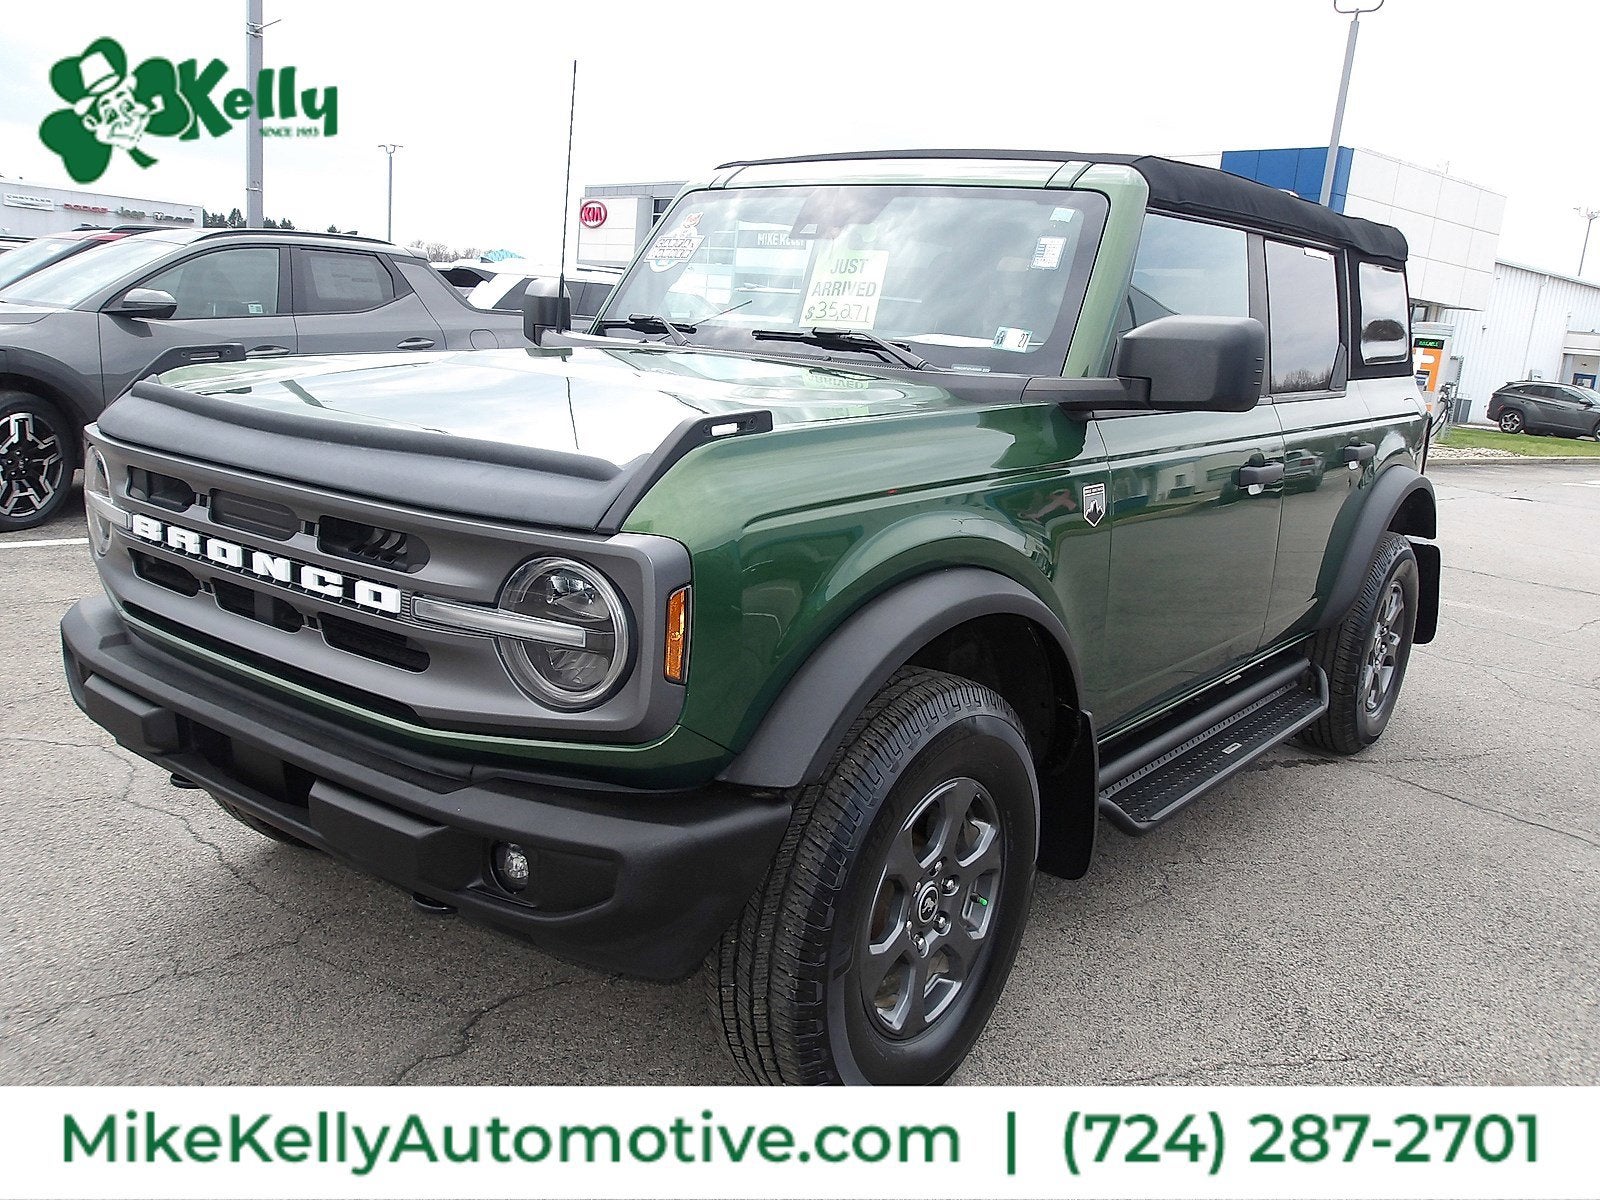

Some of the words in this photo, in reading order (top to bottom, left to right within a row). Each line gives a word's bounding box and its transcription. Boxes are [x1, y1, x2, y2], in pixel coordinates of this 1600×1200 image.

[116, 206, 146, 219] Jeep
[583, 206, 603, 222] KIA
[757, 232, 778, 246] MIKE
[830, 258, 869, 274] JUST
[811, 281, 877, 297] ARRIVED
[130, 512, 403, 615] BRONCO
